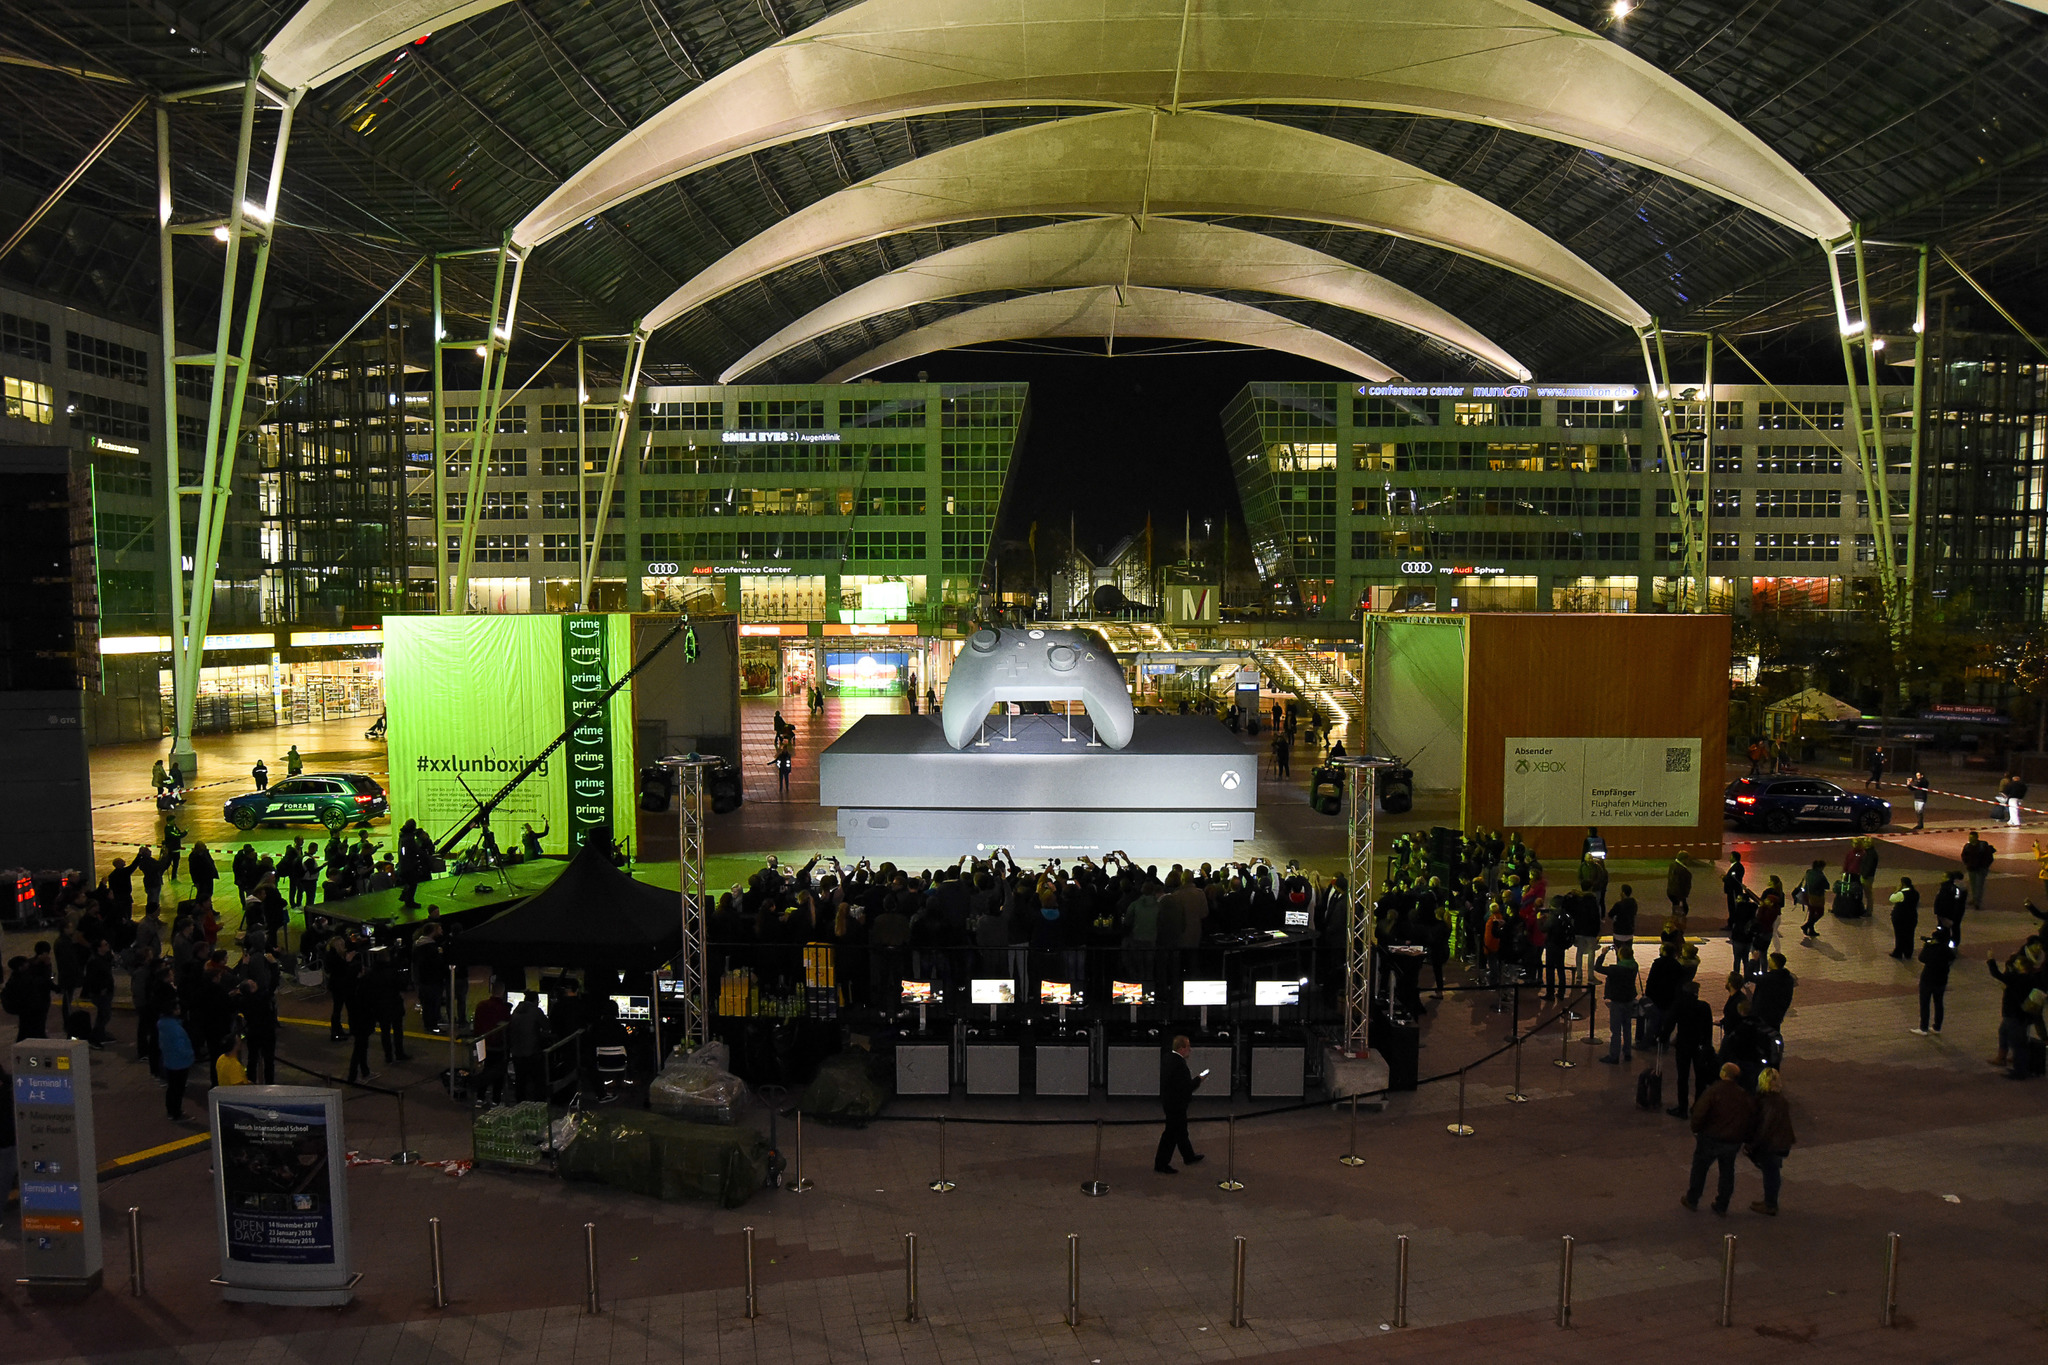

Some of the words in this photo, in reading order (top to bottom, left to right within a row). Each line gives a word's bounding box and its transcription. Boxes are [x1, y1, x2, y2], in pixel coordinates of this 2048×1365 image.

[1368, 384, 1428, 396] conference
[1429, 386, 1465, 396] center
[1537, 386, 1628, 397] www.municon.de
[721, 432, 757, 442] SMILE
[758, 432, 788, 442] EYES
[800, 433, 840, 443] Augenklinik
[692, 566, 713, 574] Audi
[713, 566, 761, 574] Conference
[762, 566, 791, 574] Center
[1440, 566, 1472, 575] myAudi
[1474, 566, 1505, 575] Sphere
[1182, 588, 1211, 621] M
[570, 618, 600, 631] prime
[206, 635, 252, 646] EDEKA
[329, 632, 367, 642] EDEKA
[570, 645, 601, 658] prime
[571, 672, 602, 685] prime
[572, 699, 602, 711] prim
[1515, 747, 1553, 755] Absender
[574, 751, 604, 764] prime
[1533, 762, 1567, 773] XBOX
[575, 777, 605, 790] prime
[1591, 788, 1637, 797] Empfänger
[1591, 800, 1630, 809] Flughafen
[1632, 800, 1668, 808] München
[575, 804, 605, 816] prime
[1665, 810, 1690, 818] Laden
[29, 1057, 38, 1067] S
[29, 1078, 62, 1088] Terminal
[253, 1124, 290, 1132] International
[290, 1124, 309, 1132] School
[34, 1161, 41, 1169] P
[24, 1183, 57, 1193] Terminal
[233, 1219, 265, 1233] OPEN
[235, 1230, 263, 1243] DAYS
[276, 1230, 297, 1238] January
[40, 1238, 46, 1246] P
[276, 1237, 300, 1245] February
